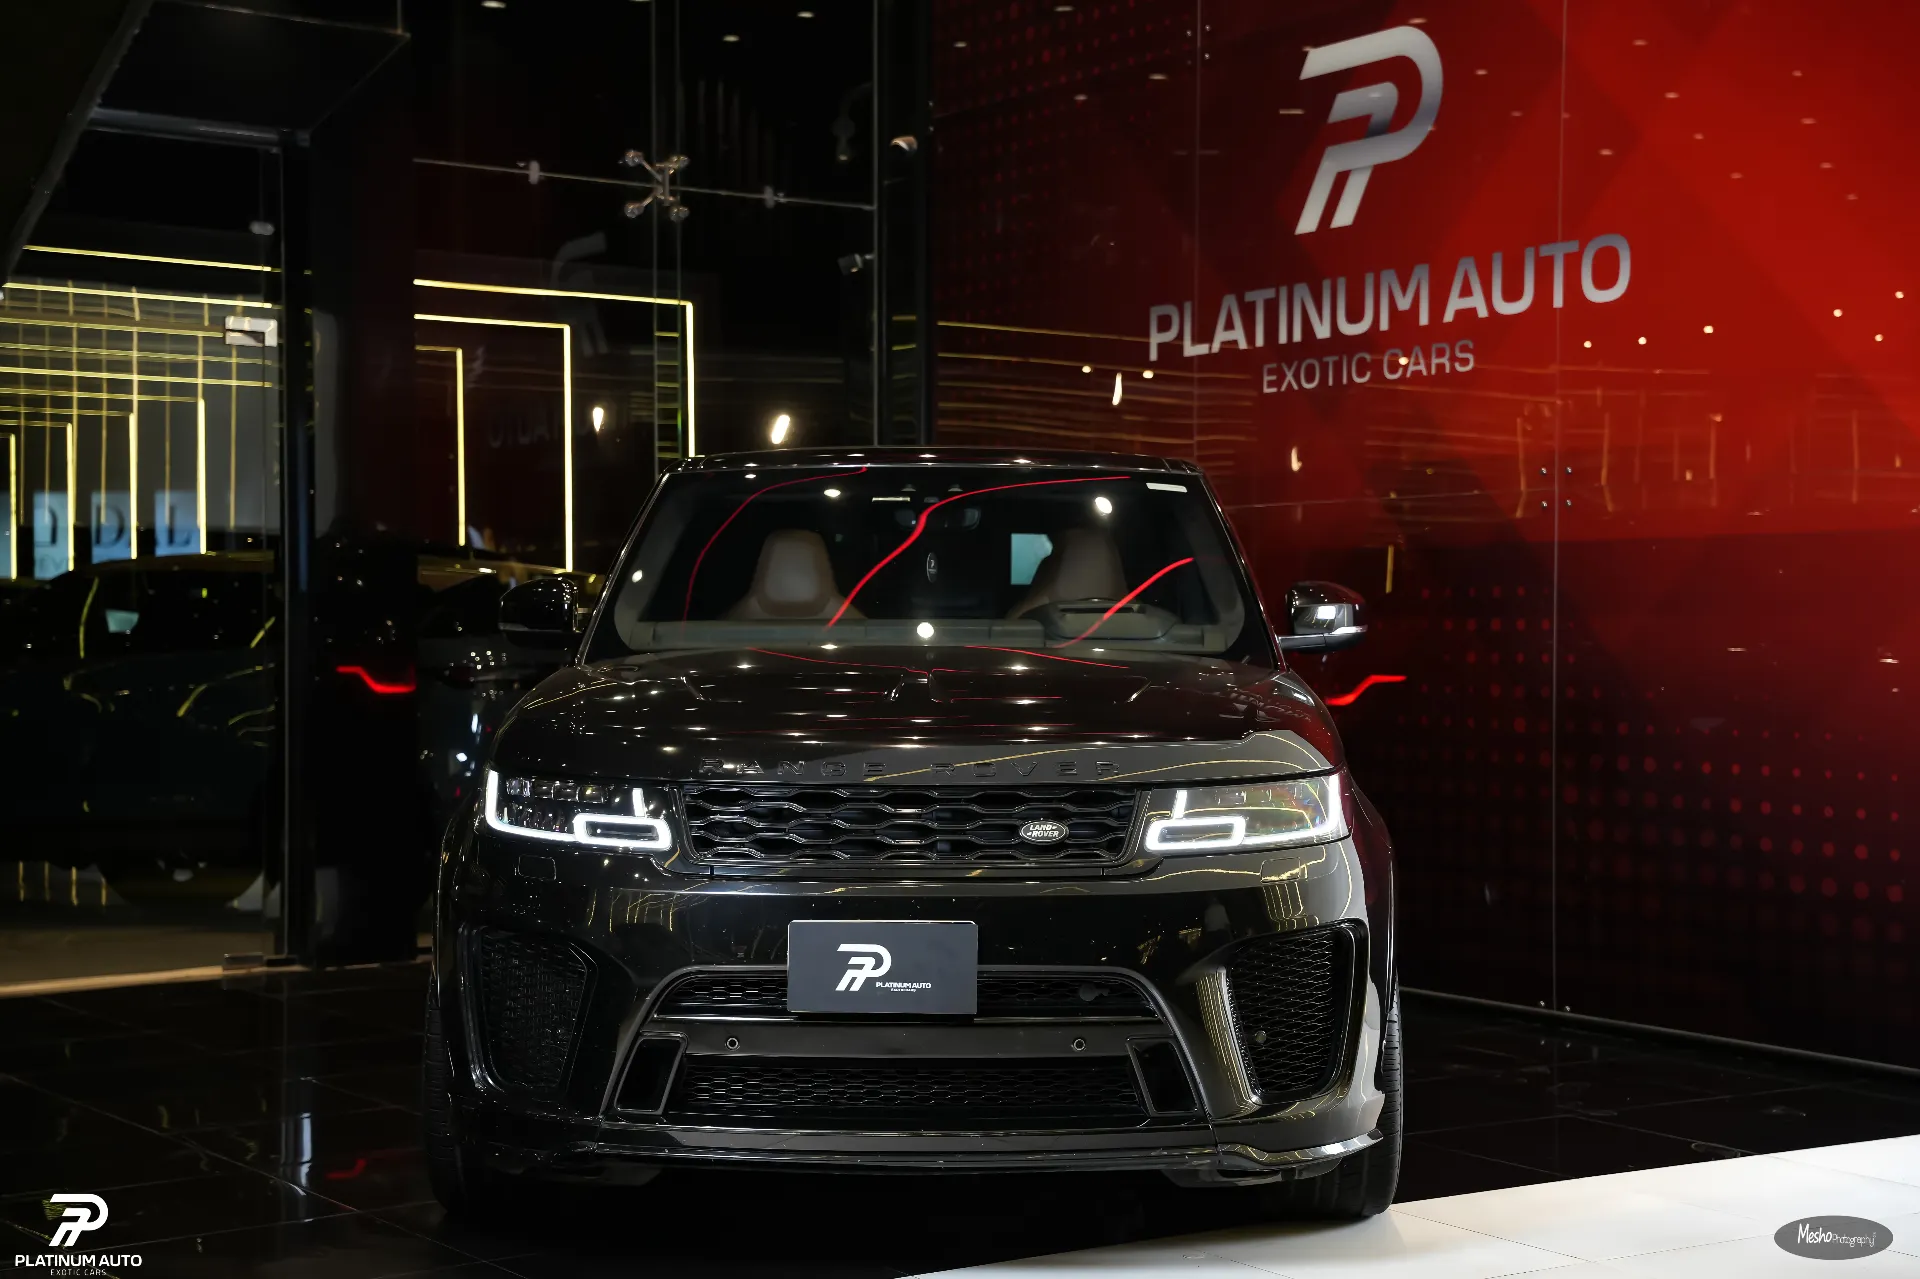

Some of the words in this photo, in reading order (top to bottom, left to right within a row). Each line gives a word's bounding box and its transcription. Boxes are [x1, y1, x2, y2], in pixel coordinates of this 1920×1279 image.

[1148, 263, 1430, 362] PLATINUM
[1441, 232, 1632, 324] AUTO
[1262, 352, 1371, 394] EXOTIC
[1382, 339, 1475, 381] CARS
[699, 757, 887, 777] RANGE
[930, 760, 1121, 778] ROVER
[875, 981, 912, 989] PLATINUM
